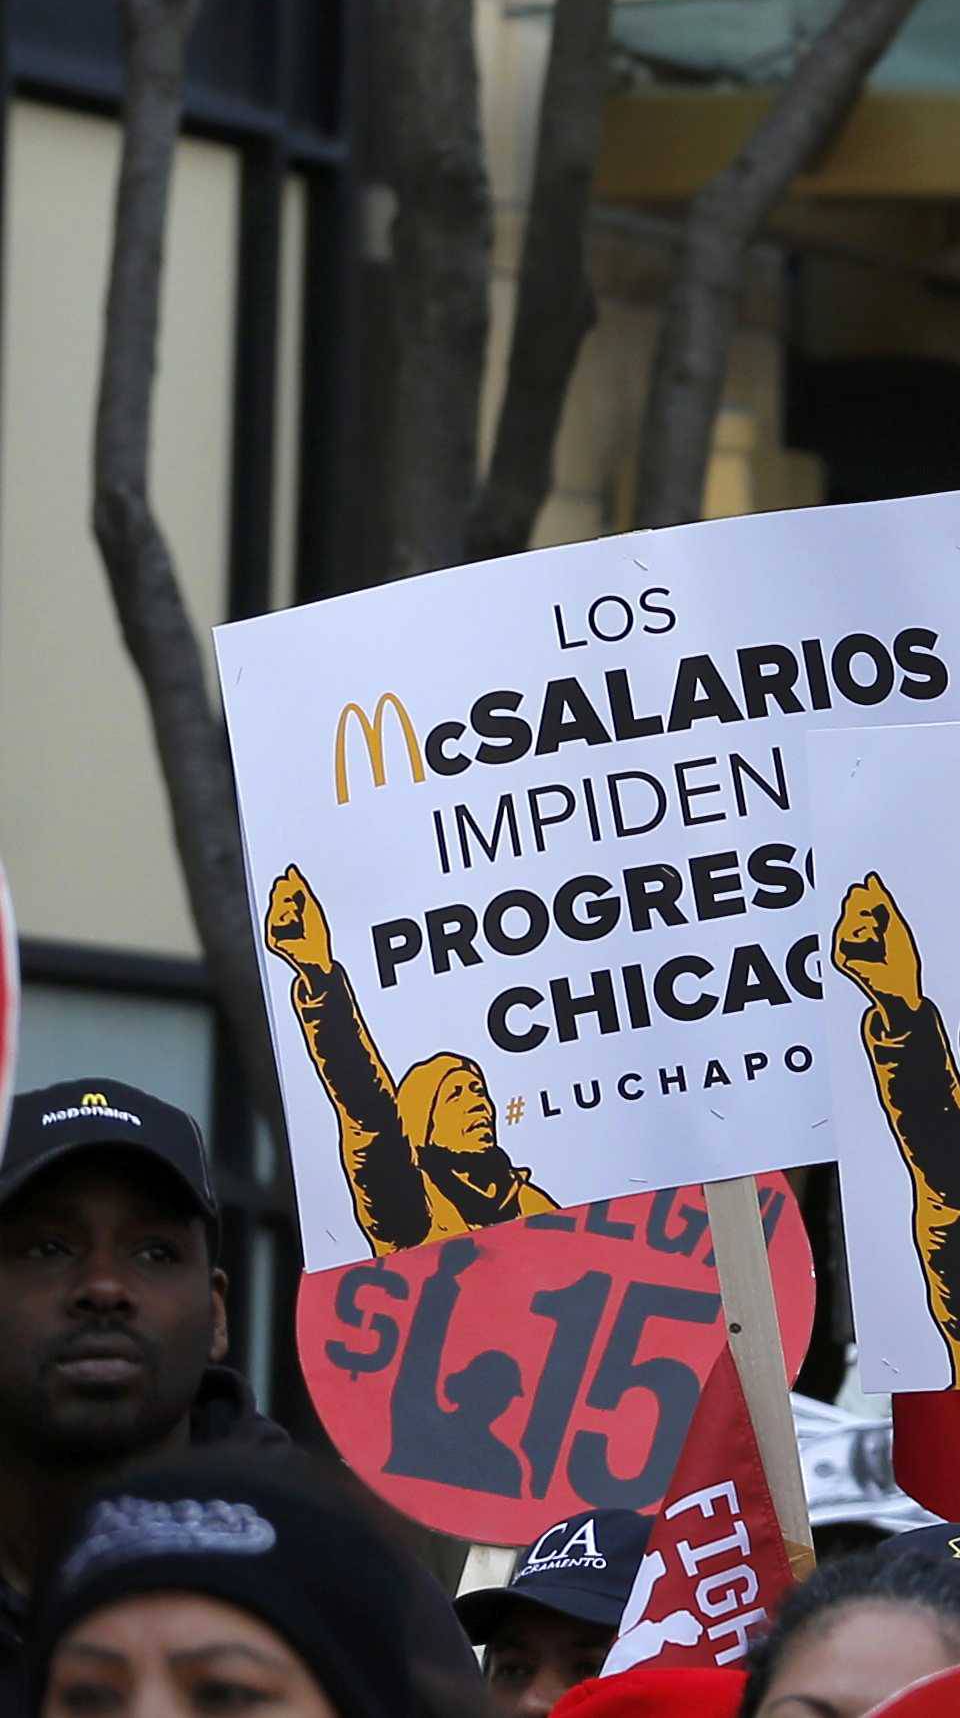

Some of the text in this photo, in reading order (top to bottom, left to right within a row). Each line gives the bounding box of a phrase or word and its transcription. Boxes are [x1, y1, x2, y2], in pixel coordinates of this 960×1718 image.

[552, 587, 677, 651] LOS
[432, 747, 790, 874] IMPIDEN
[370, 842, 816, 989] PROGRES
[505, 1045, 814, 1126] #LUCHAPO
[527, 1518, 603, 1565] CA
